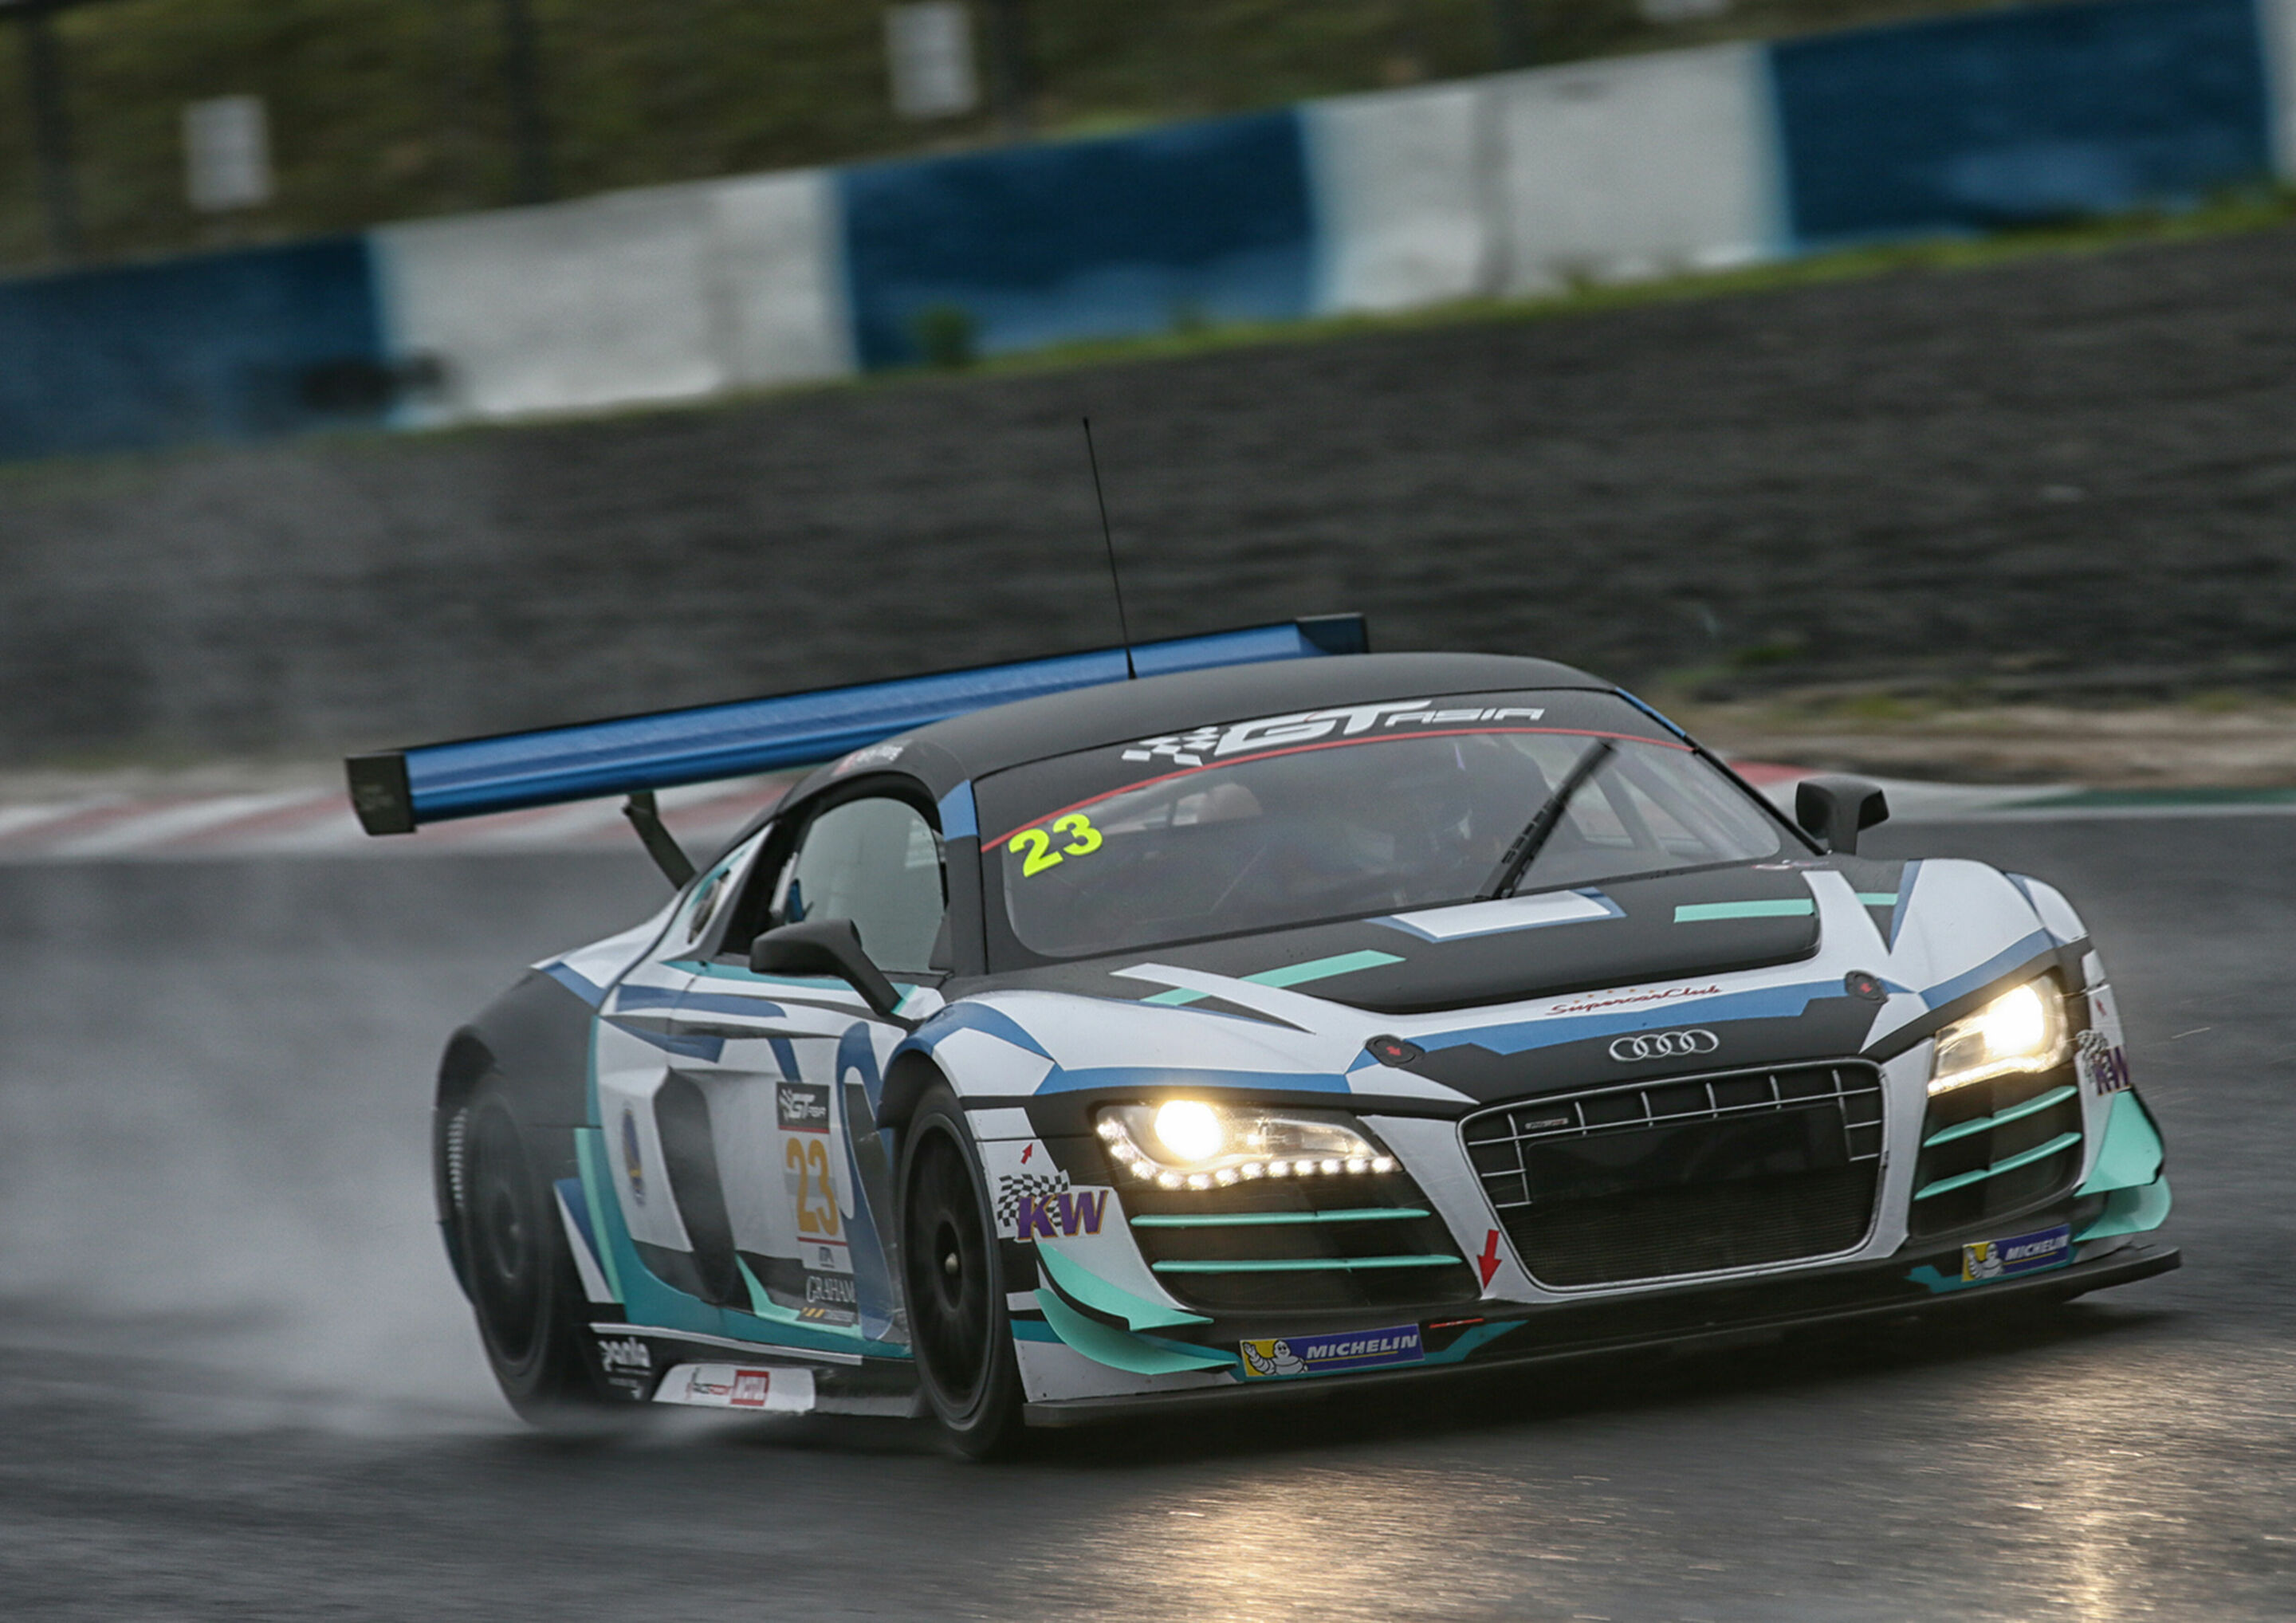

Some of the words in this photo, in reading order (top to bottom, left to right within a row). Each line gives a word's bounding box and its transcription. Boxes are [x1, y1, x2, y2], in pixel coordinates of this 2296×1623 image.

[1214, 701, 1433, 756] GT
[1008, 813, 1103, 878] 23
[786, 1137, 839, 1236] 23
[1016, 1189, 1109, 1241] KW
[2004, 1232, 2069, 1262] MICHELIN
[1306, 1334, 1418, 1360] MICHELIN
